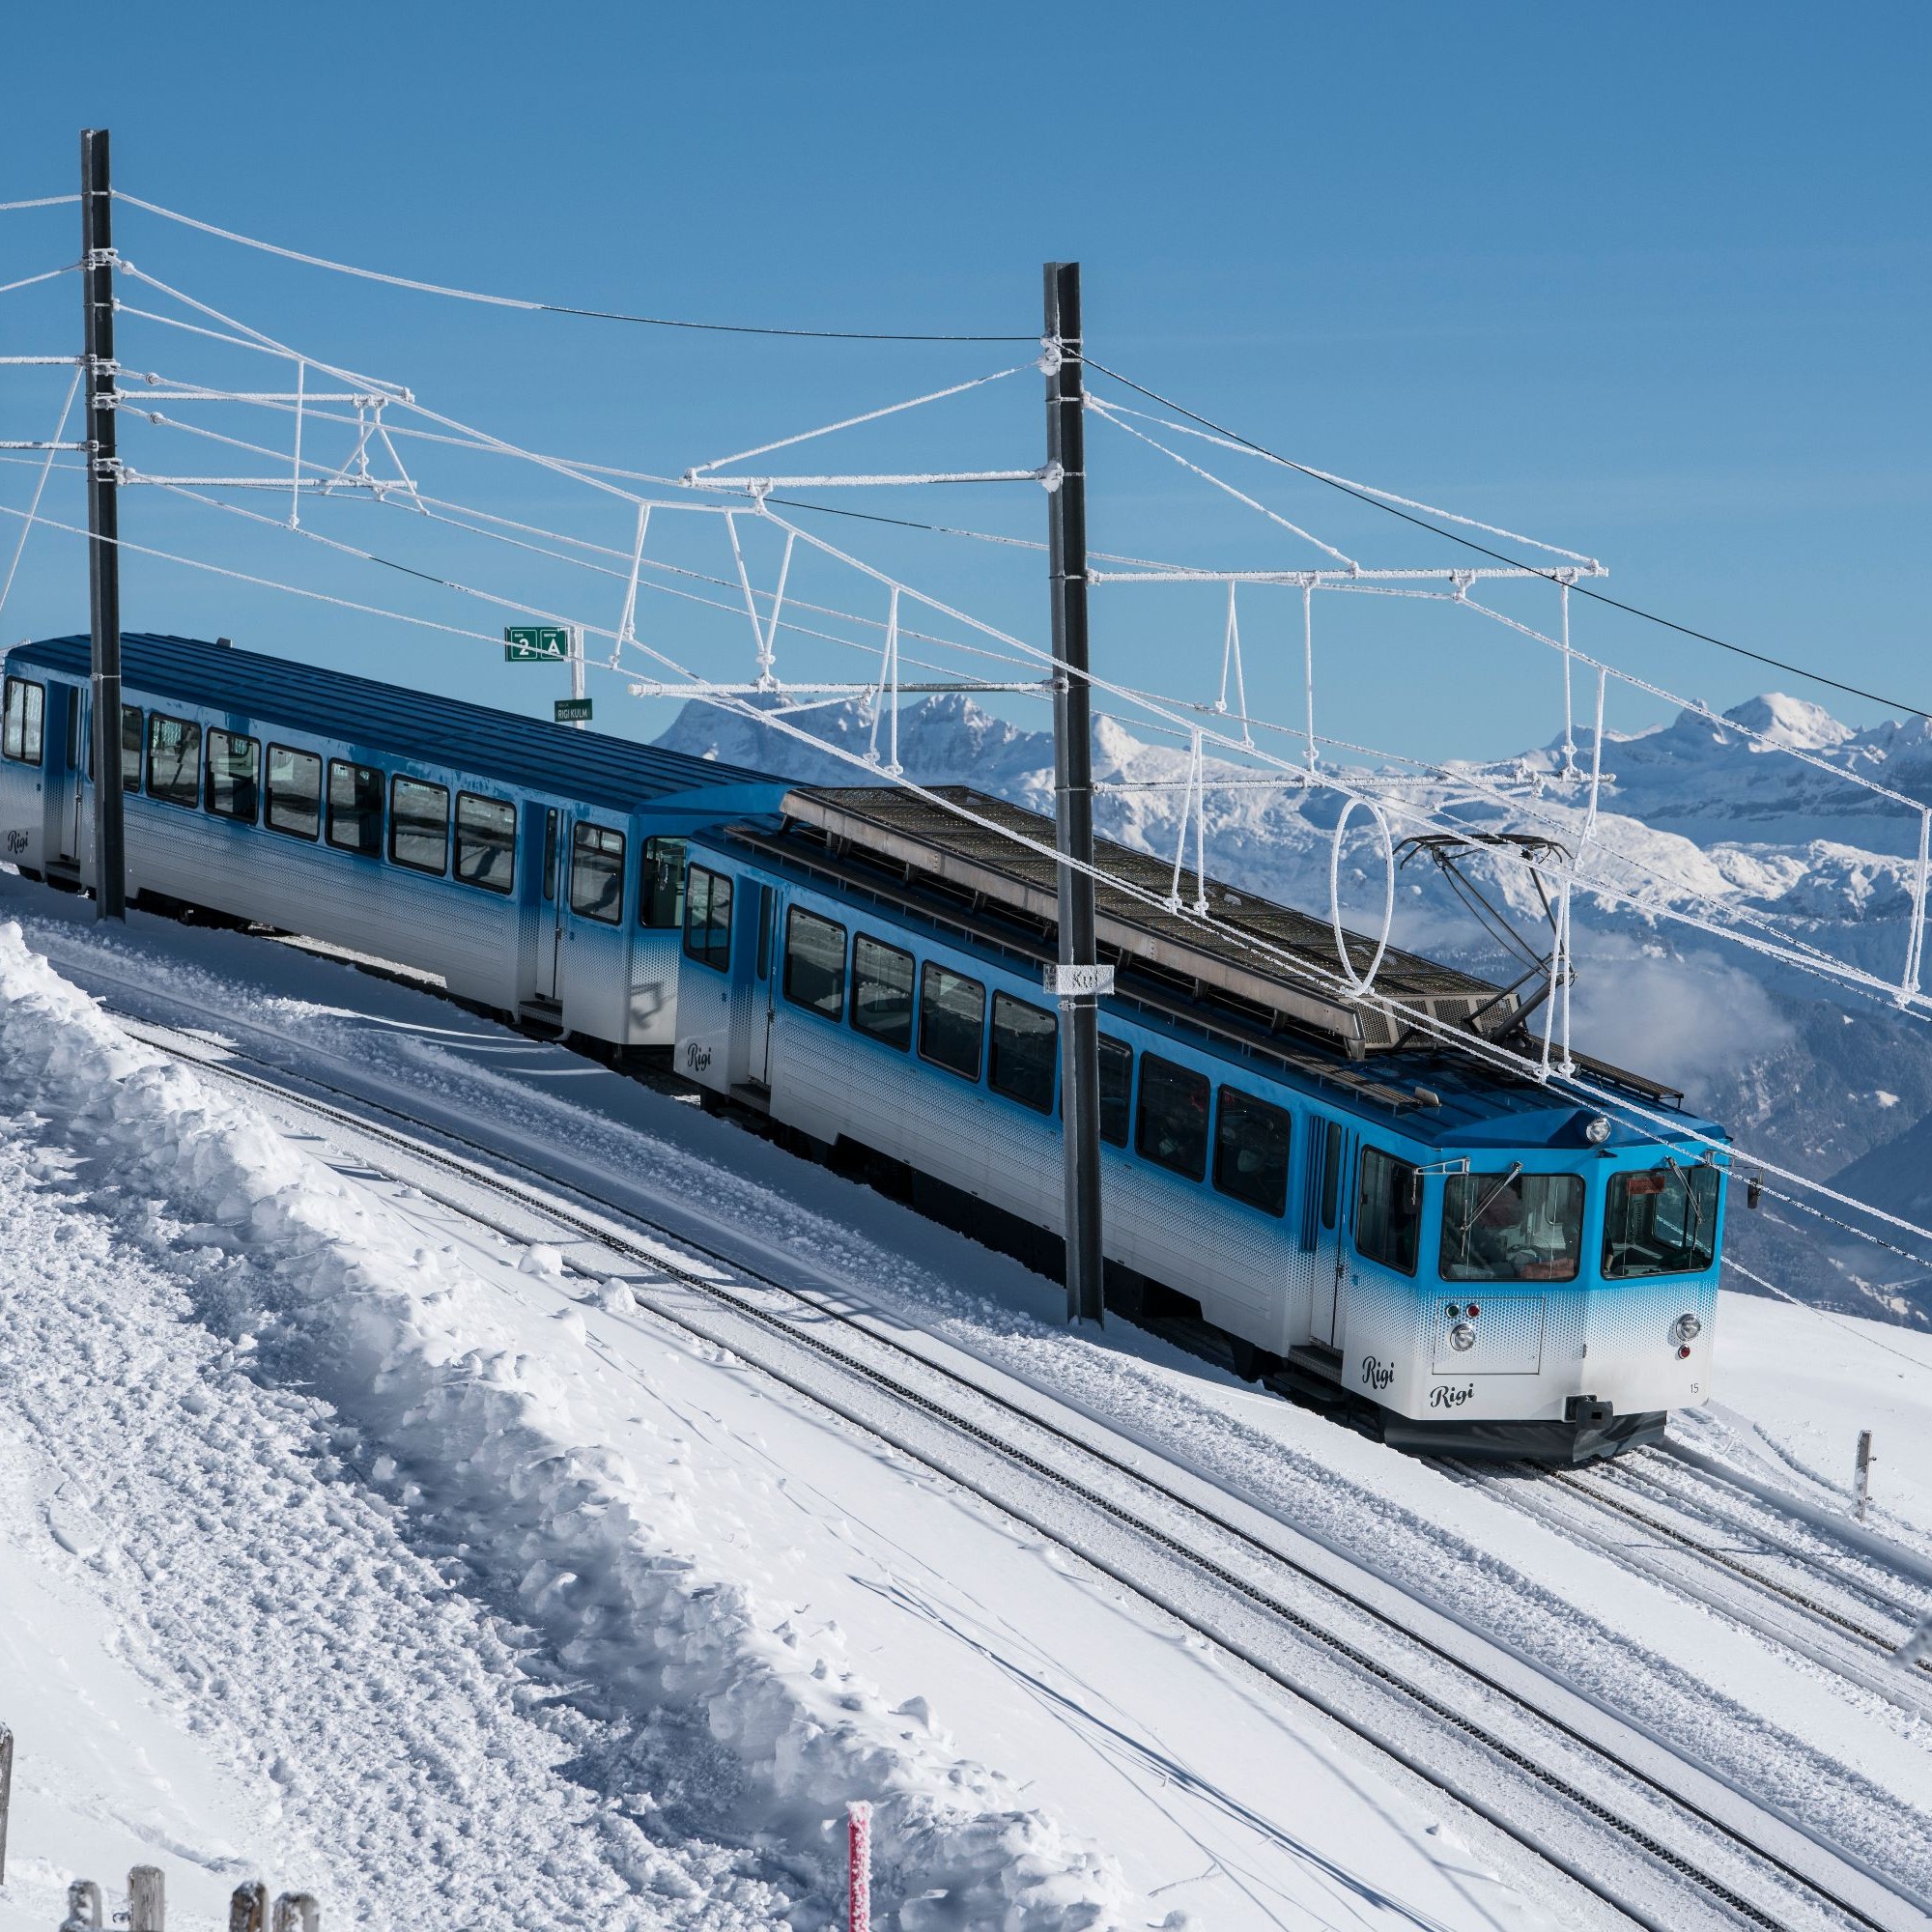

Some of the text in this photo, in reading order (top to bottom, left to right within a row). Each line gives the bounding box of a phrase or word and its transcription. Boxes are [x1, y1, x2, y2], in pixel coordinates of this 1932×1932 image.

[519, 638, 529, 656] 2
[547, 638, 561, 656] A
[557, 707, 588, 720] RIGI KULM
[8, 830, 29, 855] Rigi
[687, 1042, 712, 1072] Rigi
[1362, 1355, 1395, 1390] Rigi
[1430, 1382, 1474, 1408] Rigi
[1690, 1382, 1699, 1394] 15
